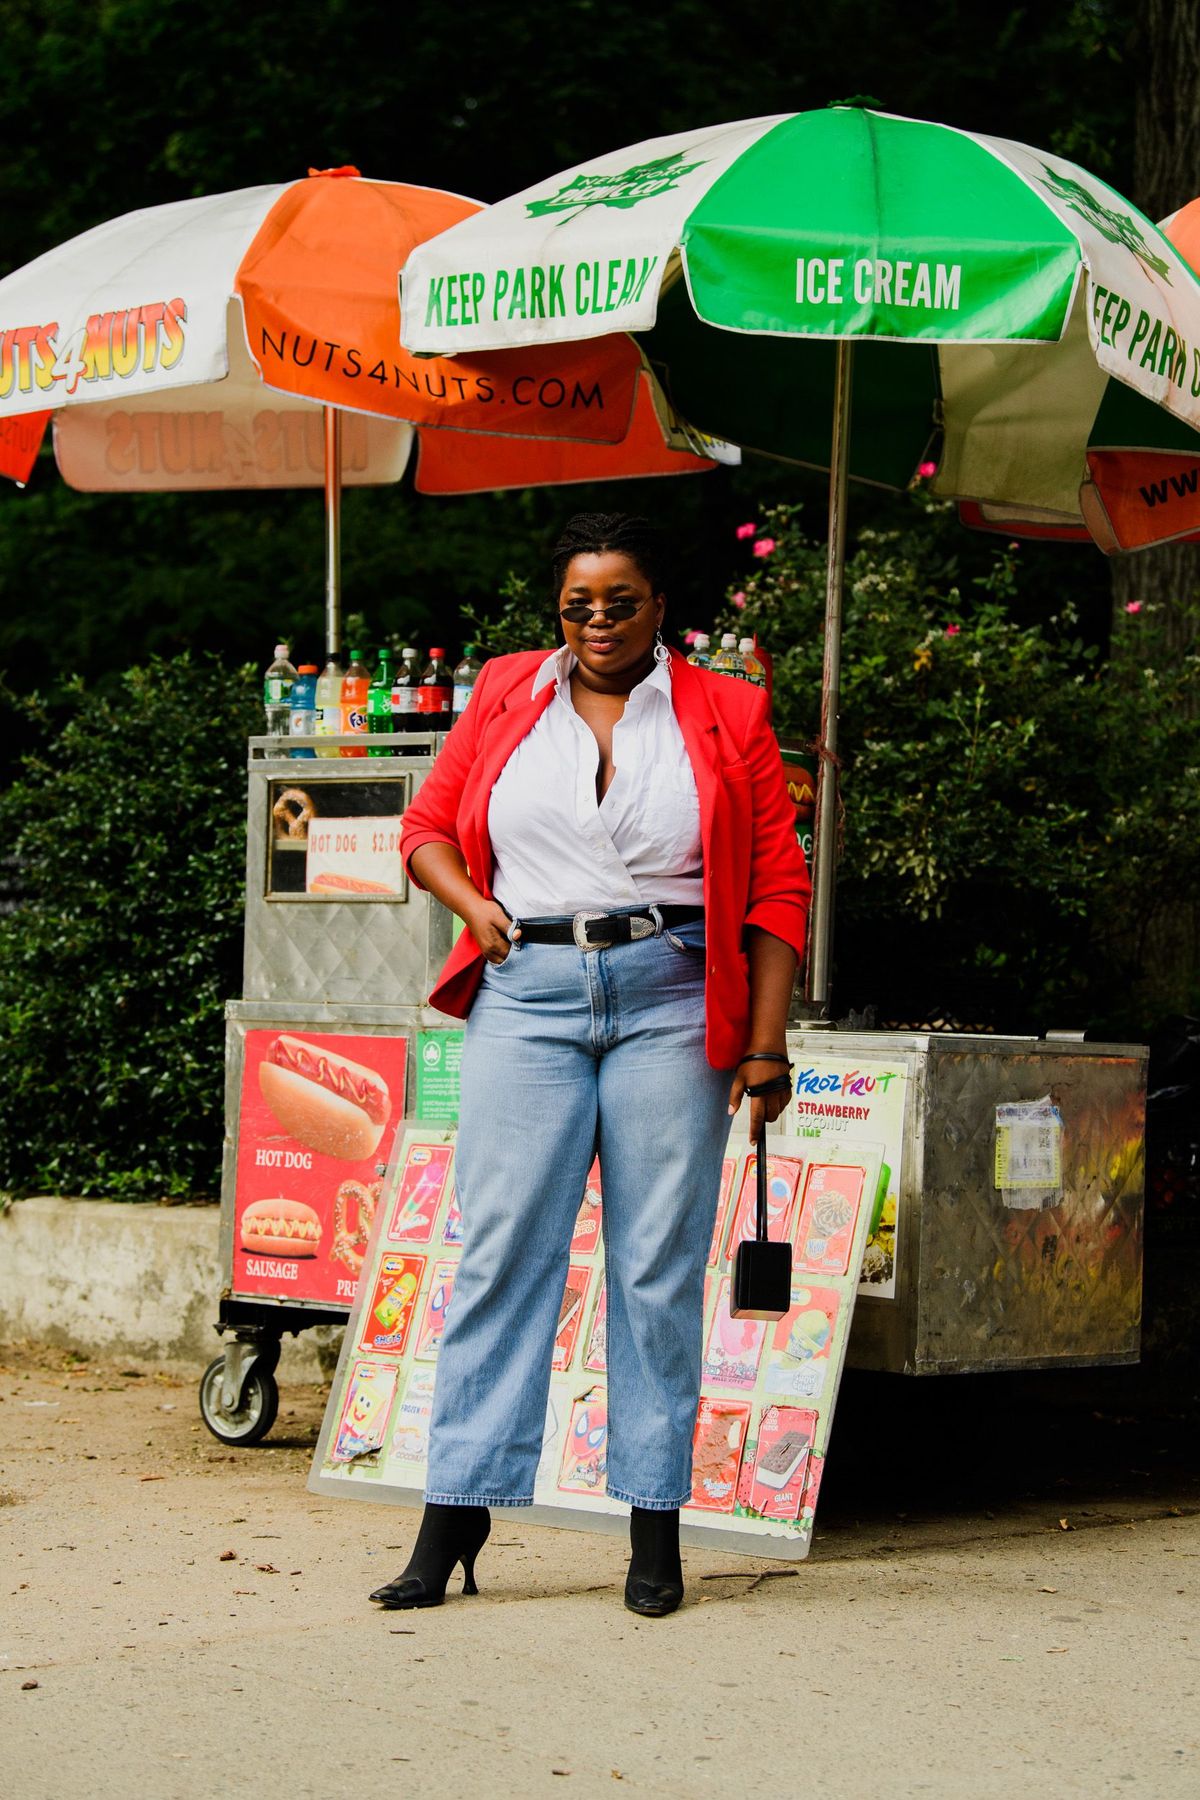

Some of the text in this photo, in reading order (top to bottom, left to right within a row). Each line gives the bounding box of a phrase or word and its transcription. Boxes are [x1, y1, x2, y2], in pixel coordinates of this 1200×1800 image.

[424, 255, 659, 328] KEEP PARK CLEAN
[796, 258, 962, 311] ICE CREAM
[1090, 282, 1132, 350] EEP
[1128, 309, 1188, 390] PARK
[262, 327, 605, 410] NUTS4NUTS.COM
[310, 834, 331, 853] HOT
[335, 833, 357, 853] DOG
[797, 1101, 871, 1121] STRAWBERRY
[798, 1116, 849, 1132] COCONUT
[255, 1149, 313, 1170] HOT DOG
[246, 1259, 299, 1280] SAUSAGE
[375, 1333, 402, 1346] SHOTS
[774, 1492, 794, 1503] GIANT
